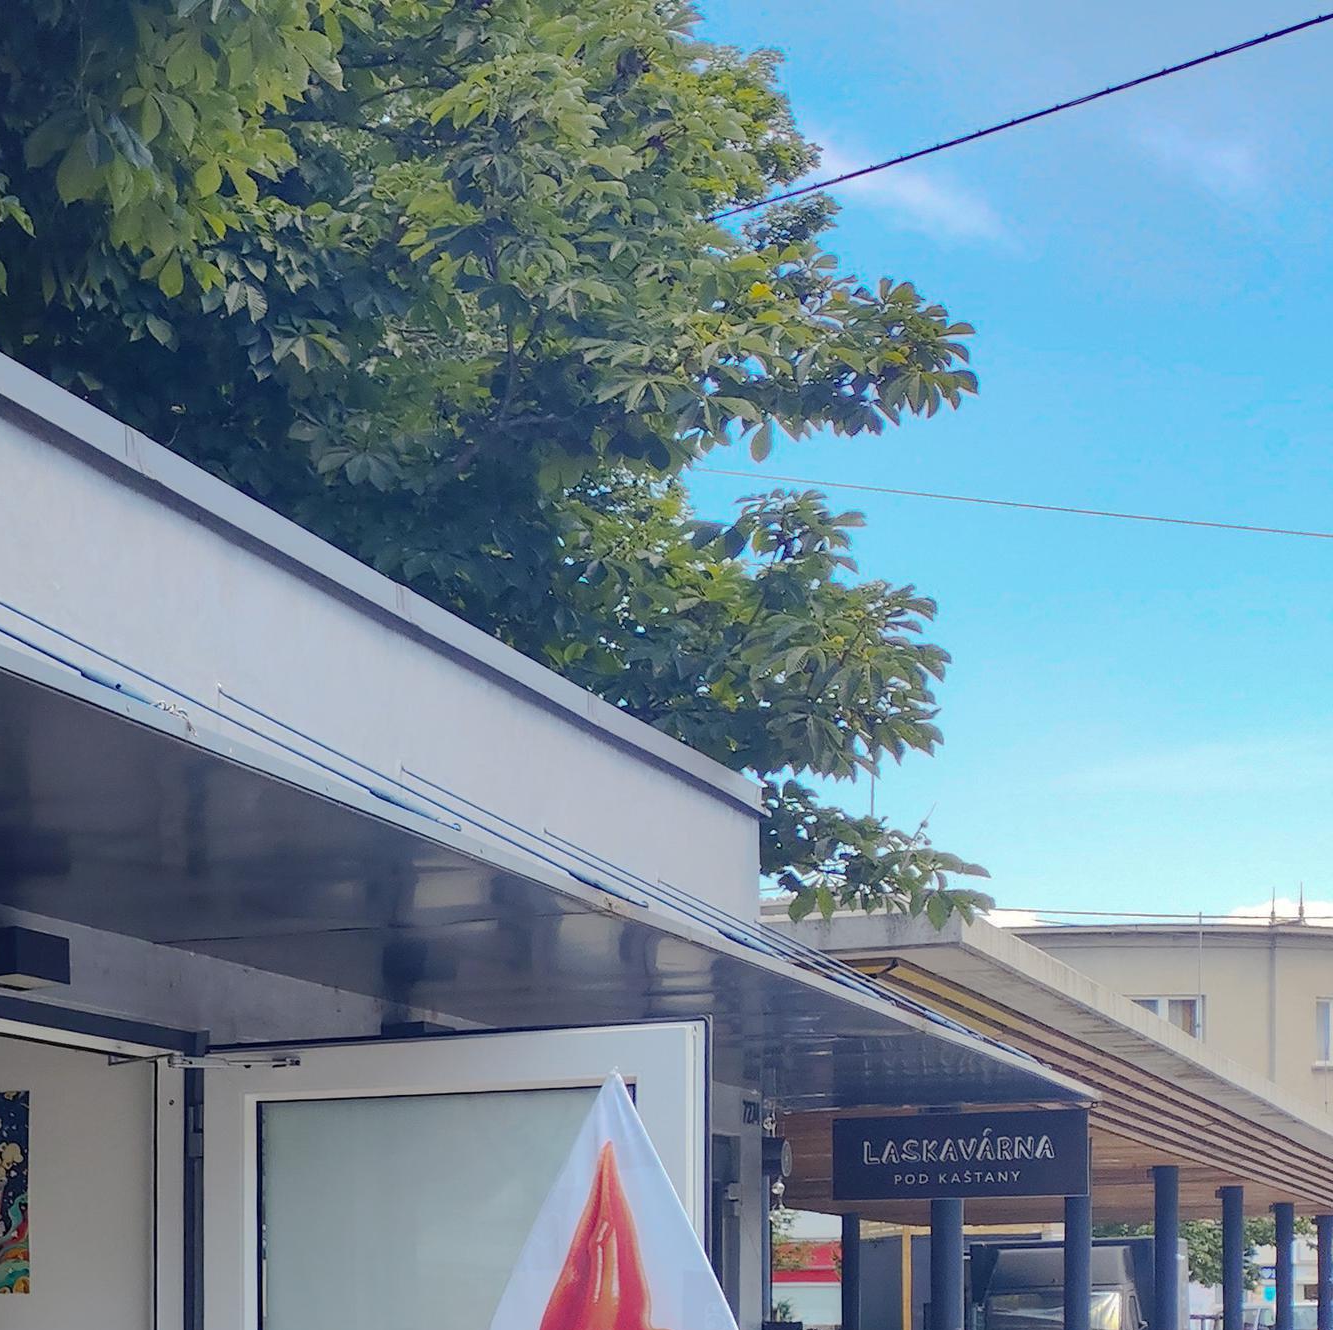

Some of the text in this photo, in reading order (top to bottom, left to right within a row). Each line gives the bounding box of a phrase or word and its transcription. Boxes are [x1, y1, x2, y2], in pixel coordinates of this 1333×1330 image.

[863, 1127, 1055, 1166] LASKAVÁRNA
[894, 1170, 1021, 1185] POD KAŠTANY
